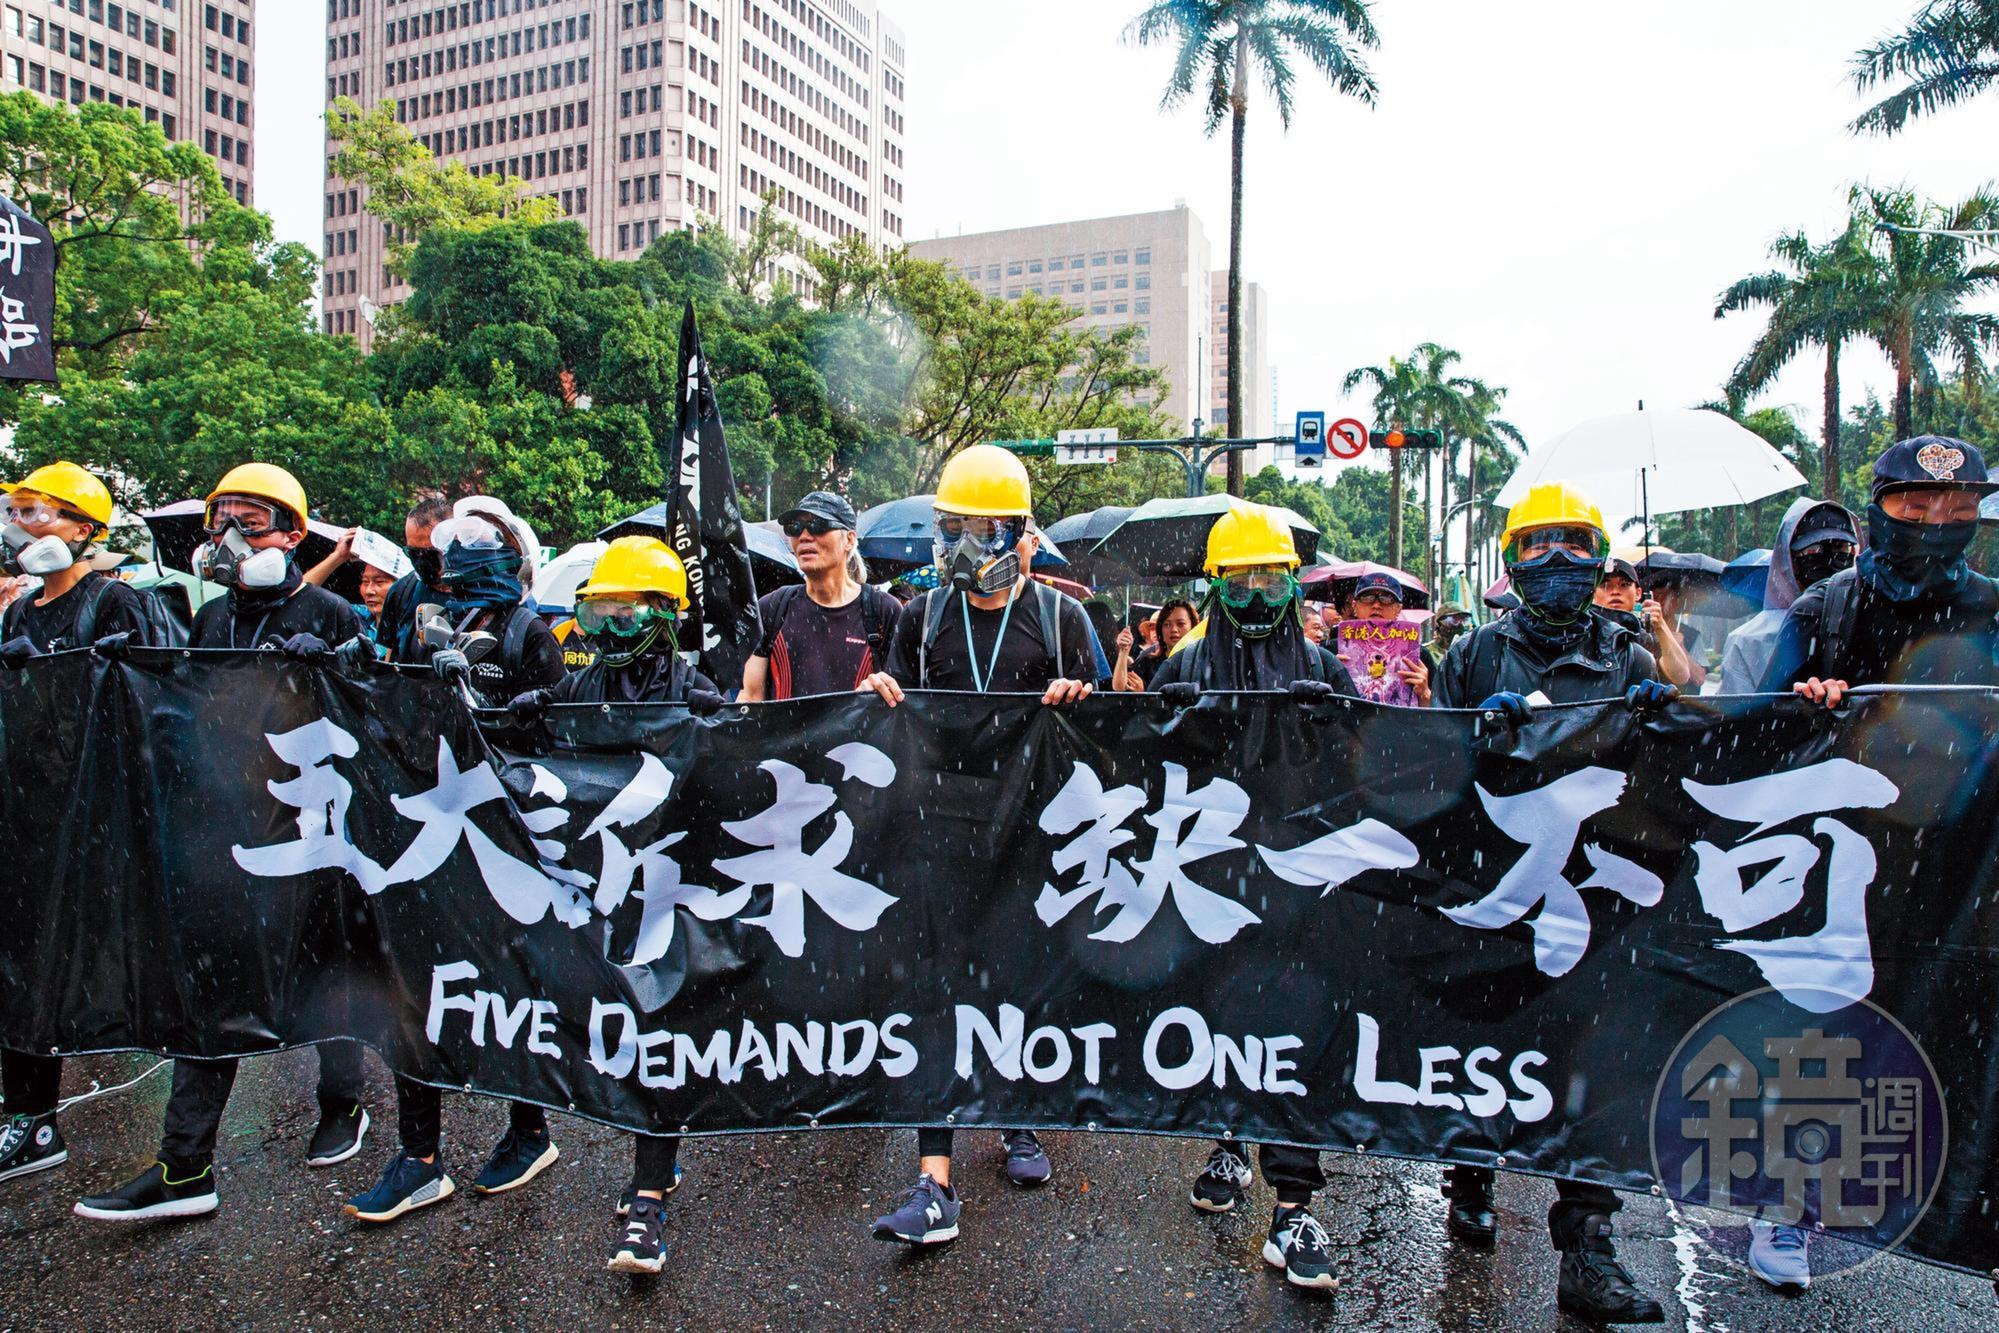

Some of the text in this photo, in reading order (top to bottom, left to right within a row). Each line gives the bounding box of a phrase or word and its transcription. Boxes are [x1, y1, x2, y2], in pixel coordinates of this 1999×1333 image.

[1342, 626, 1419, 641] 香港人加油
